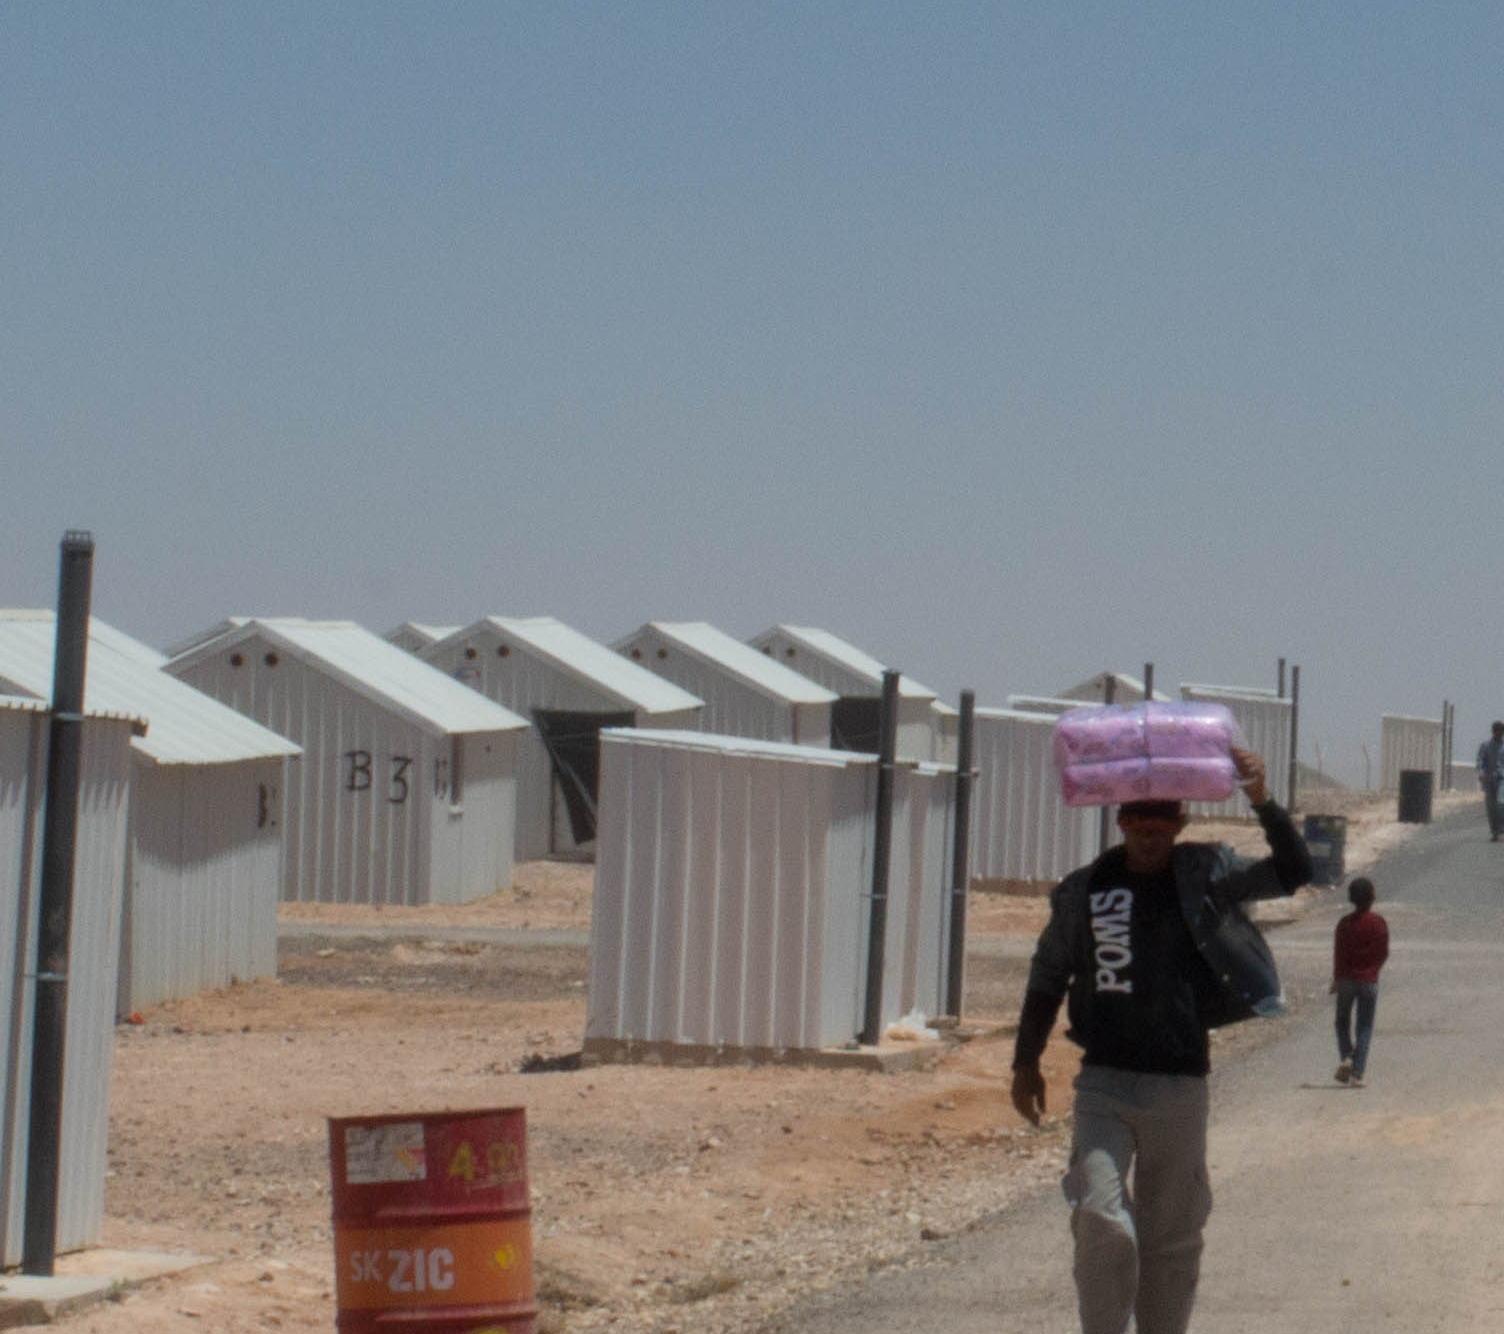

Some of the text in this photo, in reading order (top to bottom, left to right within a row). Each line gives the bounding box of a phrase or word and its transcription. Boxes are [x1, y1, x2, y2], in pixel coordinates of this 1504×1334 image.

[1088, 887, 1135, 995] POMS
[350, 1247, 455, 1292] SK ZIC
